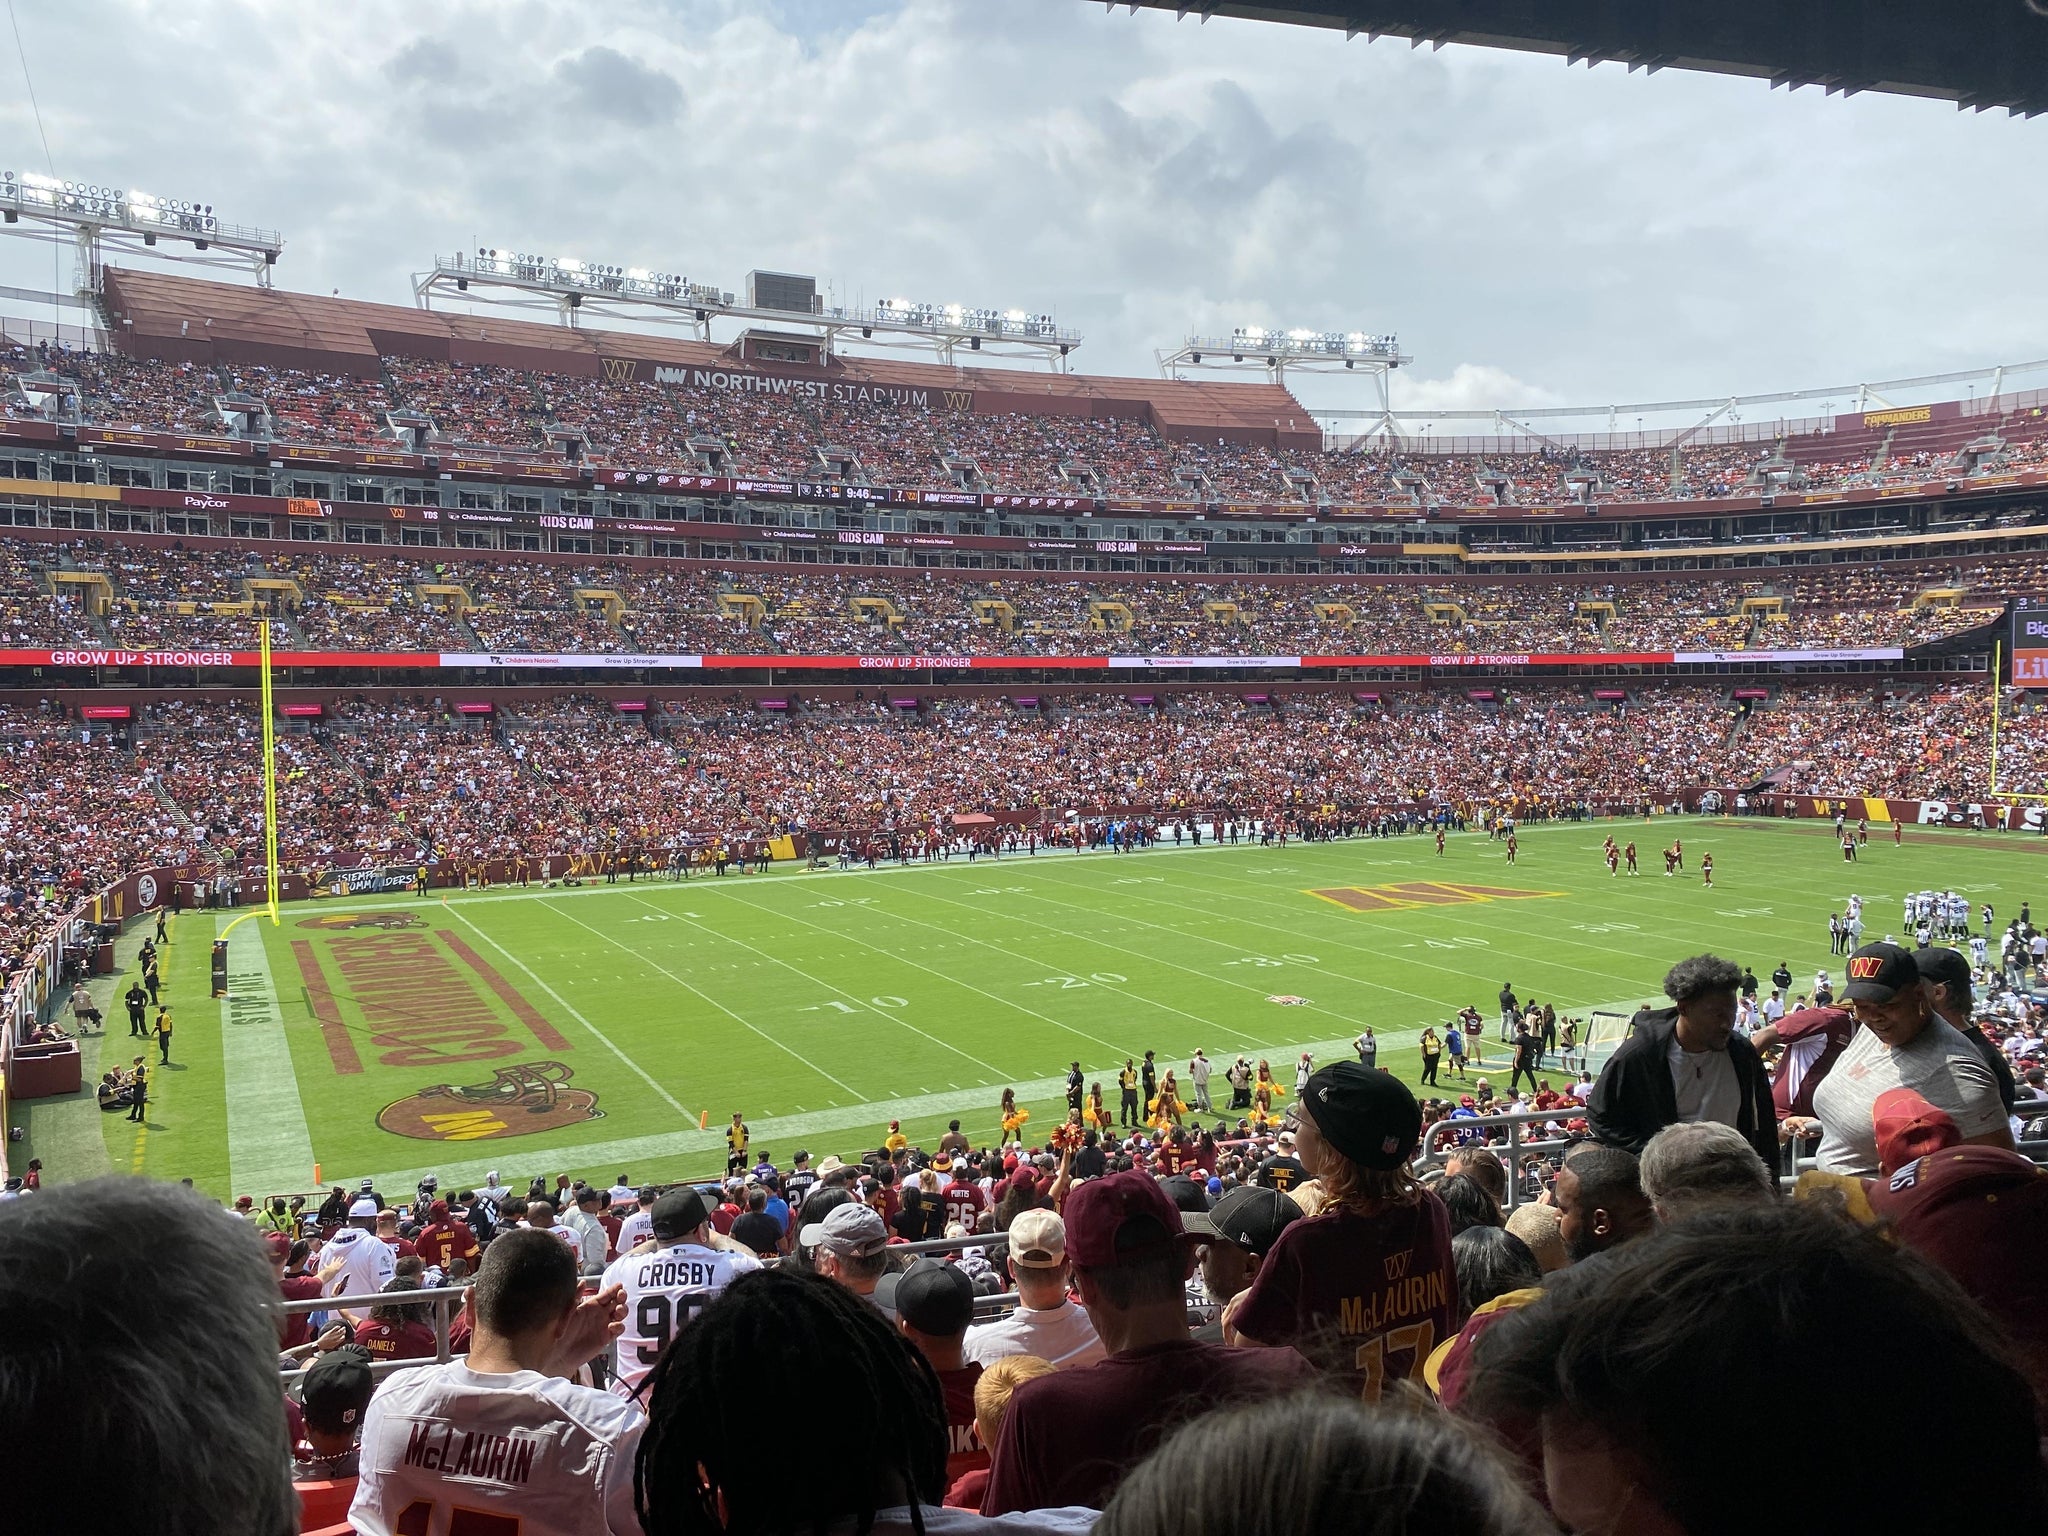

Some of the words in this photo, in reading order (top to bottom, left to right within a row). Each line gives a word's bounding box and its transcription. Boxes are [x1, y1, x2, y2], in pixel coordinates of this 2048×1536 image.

[694, 370, 828, 398] NORTHWEST
[833, 384, 928, 406] STADIUM
[1865, 409, 1931, 425] COMMANDERS
[103, 432, 114, 442] 56
[185, 440, 196, 449] 27
[847, 488, 869, 499] 9:46
[184, 496, 230, 509] Paycor
[290, 506, 320, 514] LEADERS
[423, 511, 438, 519] YDS
[540, 516, 566, 528] KIDS
[569, 517, 593, 529] CAM
[839, 532, 861, 543] KIDS
[863, 533, 884, 544] CAM
[1096, 542, 1117, 552] KIDS
[1118, 543, 1137, 553] CAM
[1340, 546, 1367, 556] Paycor
[2019, 598, 2027, 606] 3
[51, 651, 108, 665] GROW
[115, 652, 138, 665] UP
[143, 652, 232, 665] STRONGER
[633, 657, 659, 665] Stronger
[860, 657, 894, 667] GROW
[898, 657, 912, 667] UP
[915, 657, 971, 667] STRONGER
[1430, 656, 1461, 665] GROW
[1463, 656, 1476, 665] UP
[1479, 655, 1529, 664] STRONGER
[1974, 942, 1984, 951] 41
[1240, 953, 1320, 967] 30
[228, 972, 266, 993] HATE
[1044, 972, 1128, 989] 20
[324, 932, 527, 1067] COMMANDERS
[822, 995, 909, 1014] 10
[230, 996, 273, 1025] STOP
[1172, 1157, 1180, 1173] 5
[951, 1190, 970, 1198] PORTIS
[946, 1203, 975, 1230] 26
[436, 1231, 455, 1241] DANIELS
[441, 1244, 452, 1268] 5
[638, 1263, 716, 1288] CROSBY
[1340, 1268, 1448, 1336] McLAURIN
[367, 1338, 396, 1353] DANIELS
[404, 1422, 537, 1484] McLAURIN
